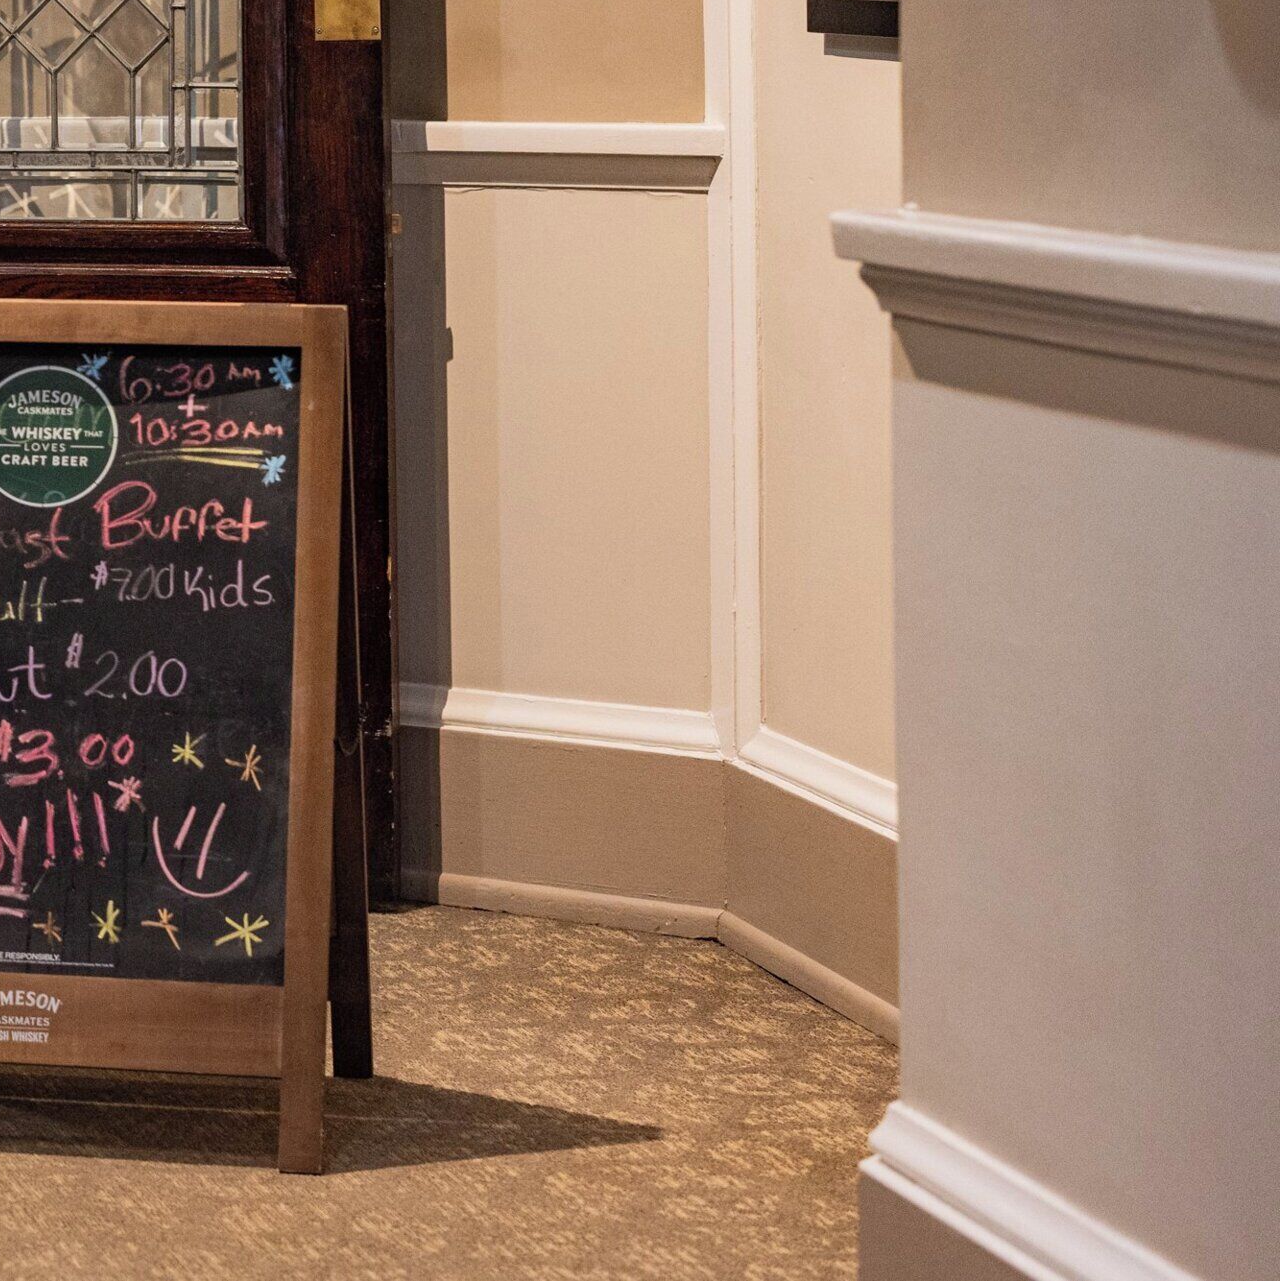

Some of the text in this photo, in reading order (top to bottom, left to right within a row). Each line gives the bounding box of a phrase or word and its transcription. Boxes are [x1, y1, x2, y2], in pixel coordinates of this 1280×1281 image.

[8, 389, 82, 410] JAMESON
[17, 406, 74, 416] CASKMATES
[11, 426, 83, 441] WHISKEY
[23, 442, 67, 453] LOVES
[1, 454, 89, 468] CRAFT BEER
[92, 480, 268, 549] Buffet
[183, 559, 274, 612] Kids
[11, 1029, 49, 1043] WHISKEY
